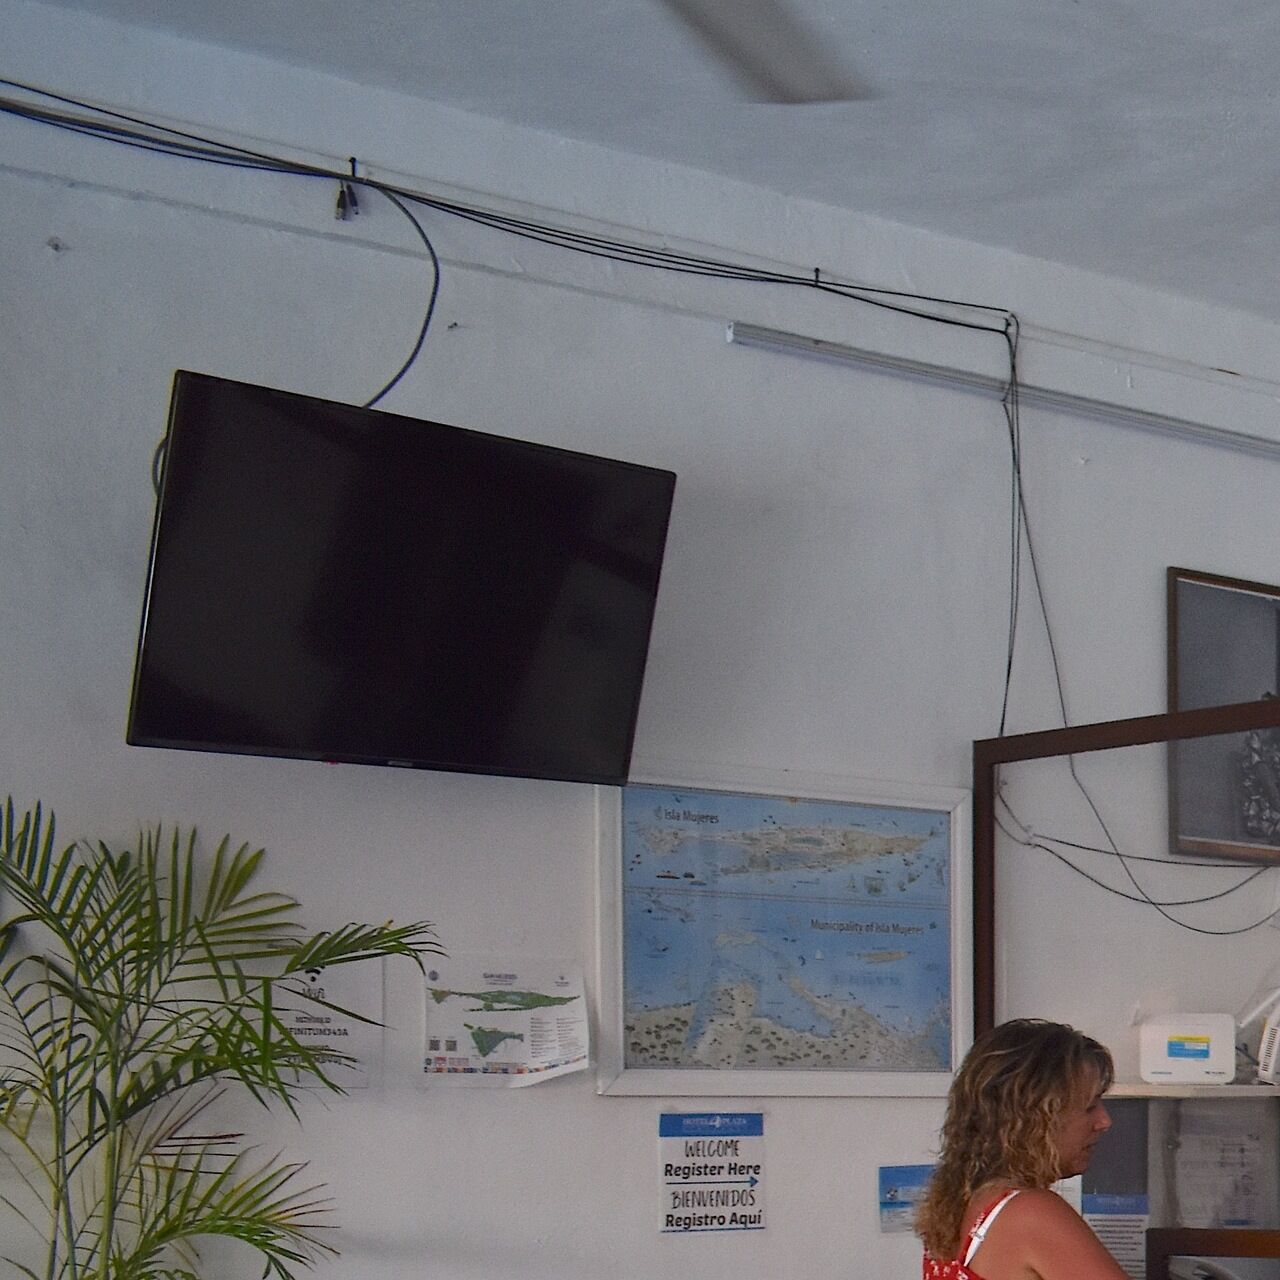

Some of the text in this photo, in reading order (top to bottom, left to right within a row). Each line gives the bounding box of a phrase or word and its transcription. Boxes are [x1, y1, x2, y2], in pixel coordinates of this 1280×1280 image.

[664, 809, 719, 824] Isla Mujeres
[811, 919, 863, 933] Municipality
[866, 922, 874, 932] of
[876, 922, 890, 933] Isla
[685, 1140, 740, 1157] WELCOME
[664, 1163, 761, 1179] Register Here
[671, 1190, 755, 1209] BIENVENIDOS
[666, 1210, 762, 1229] Registro Aquí
